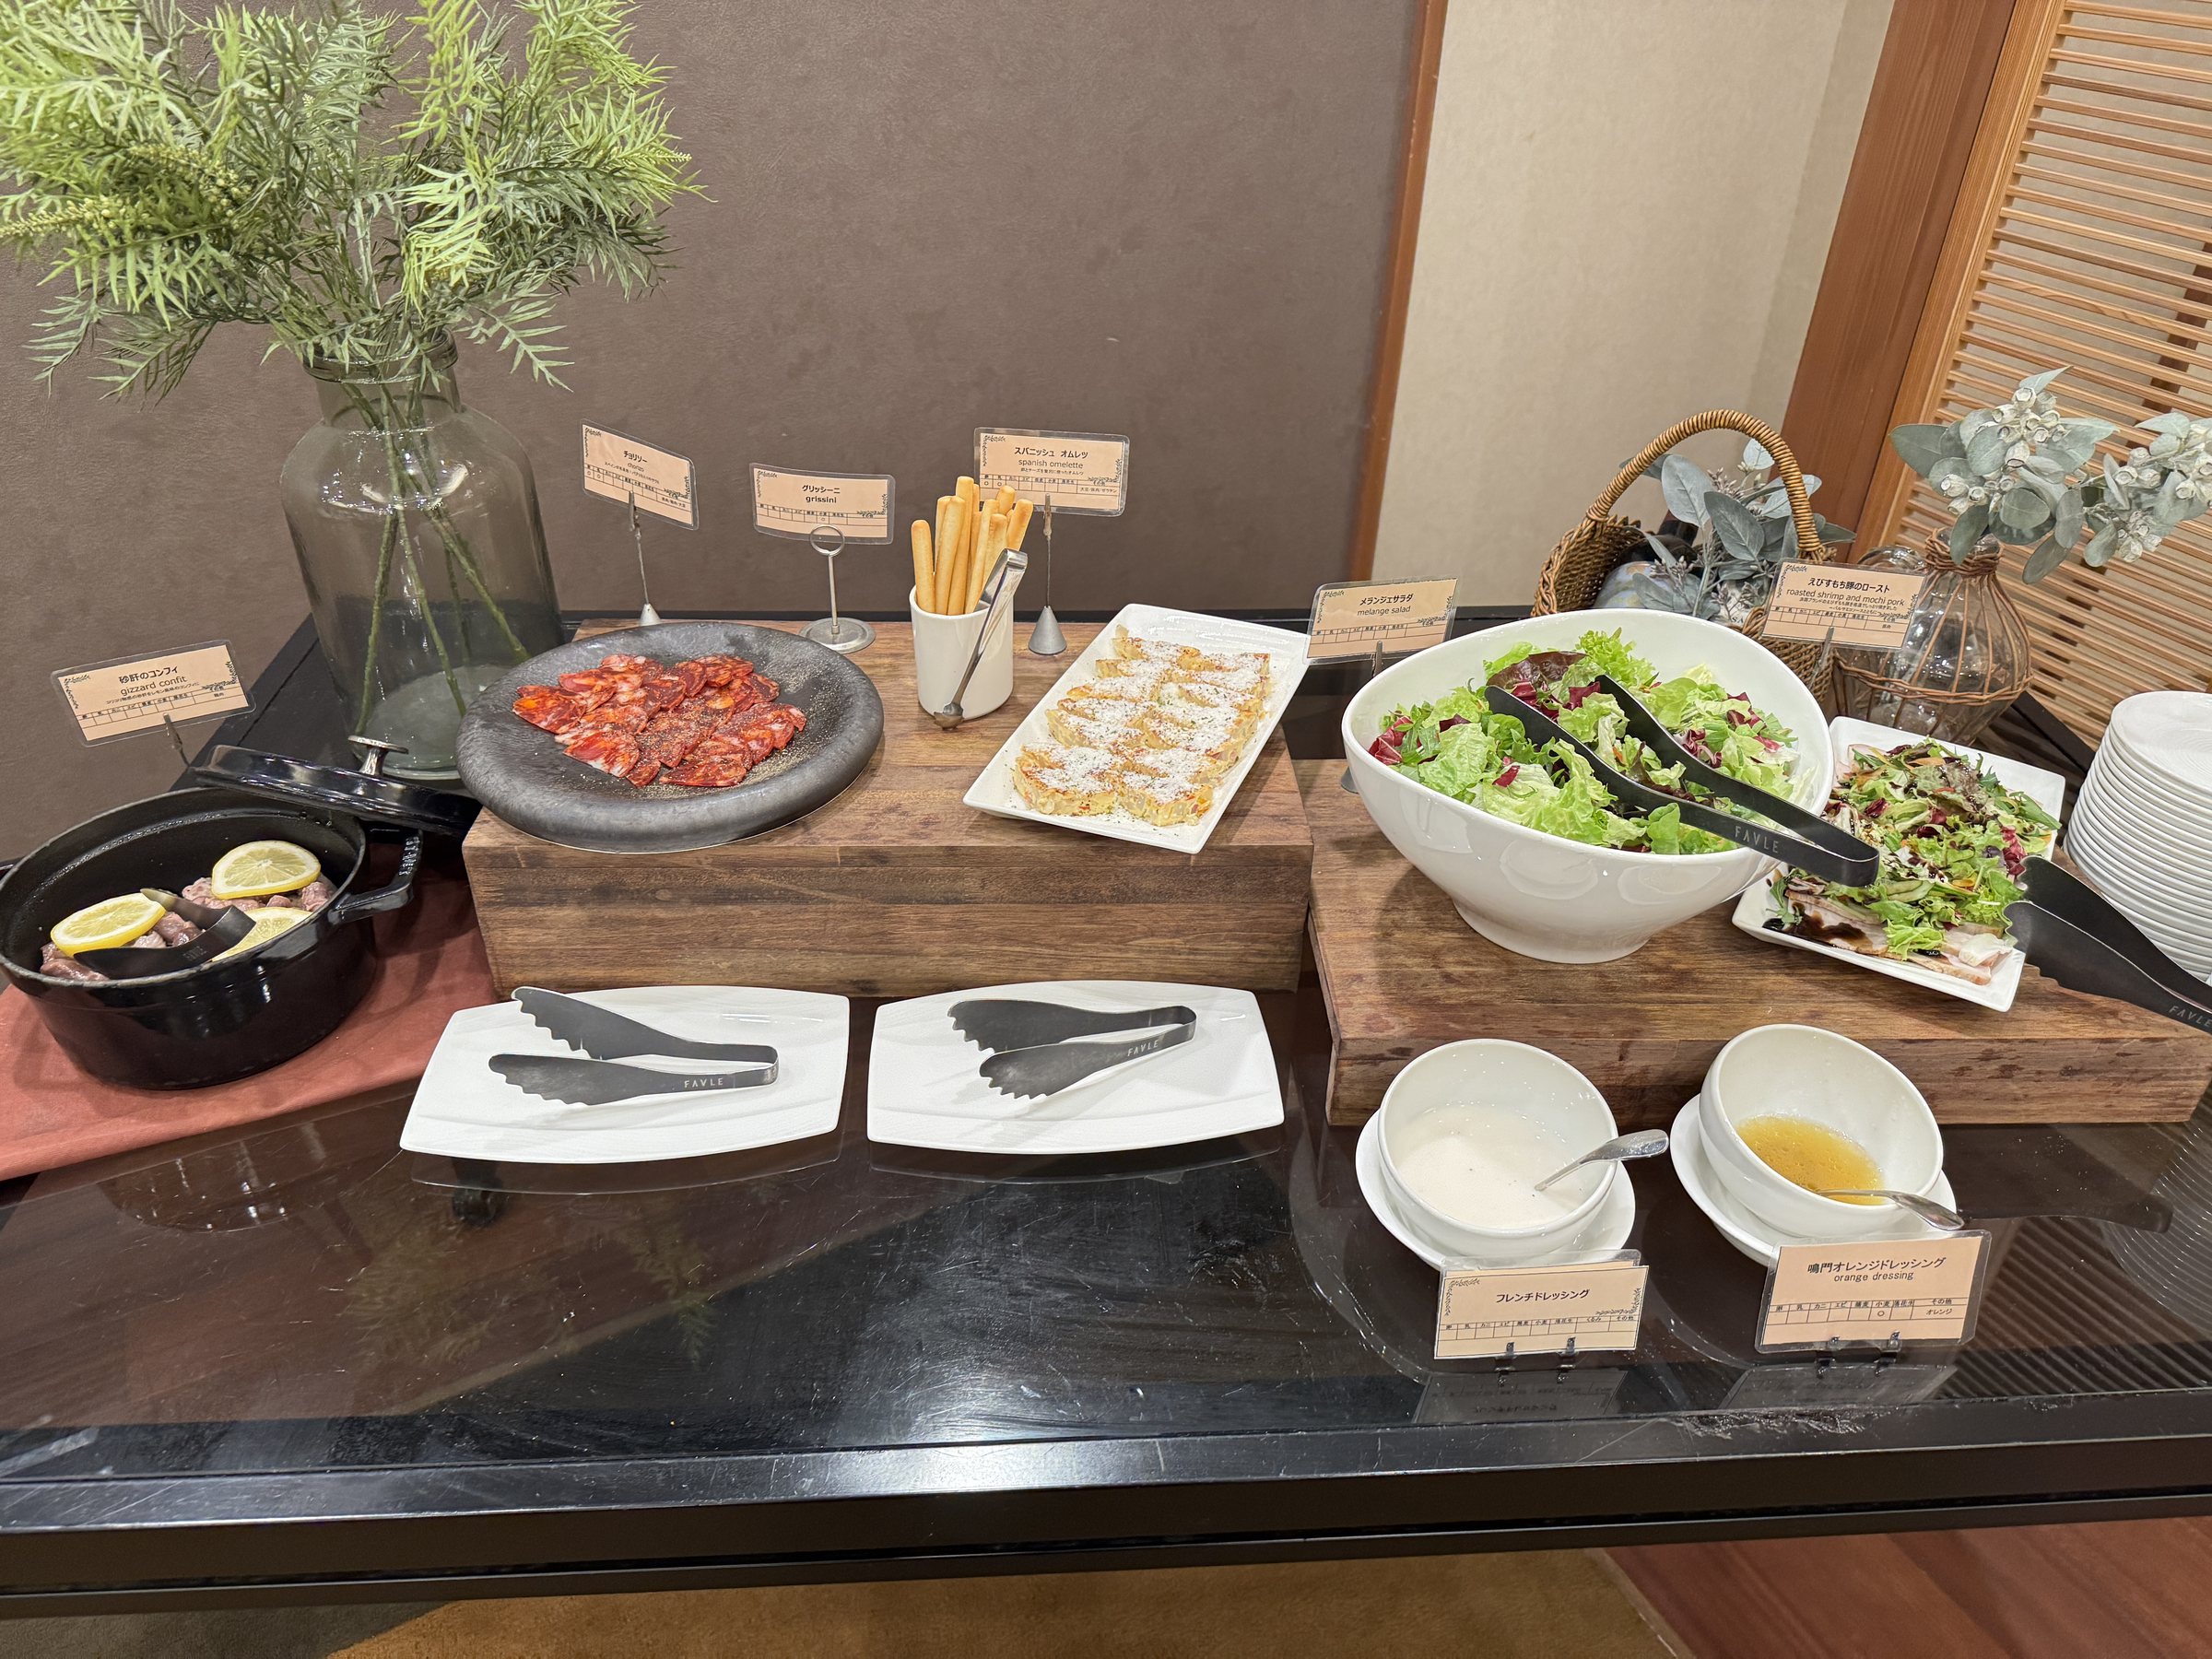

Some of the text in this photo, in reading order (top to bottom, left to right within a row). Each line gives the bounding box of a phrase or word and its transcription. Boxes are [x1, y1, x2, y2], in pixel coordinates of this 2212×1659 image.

[624, 451, 647, 463] チョリソー
[1060, 450, 1088, 459] オムレツ
[1050, 461, 1084, 469] omelette
[802, 485, 841, 494] グリッシーニ
[806, 495, 837, 504] grissini
[1808, 577, 1890, 593] えびすもち豚のロースト
[1359, 593, 1414, 606] メランジェサラダ
[1786, 588, 1816, 597] roasted
[1818, 591, 1844, 600] shrimp
[1357, 606, 1411, 617] melange salad
[119, 666, 178, 684] 砂肝のコンフィ
[121, 676, 187, 696] gizzard confit
[1735, 825, 1779, 853] FAVLE
[2169, 1006, 2212, 1028] FAVLE
[1127, 1040, 1159, 1057] FAVLE
[684, 1077, 724, 1088] FAVLE
[1807, 1256, 1947, 1274] 鳴門オレンジドレッシング
[1834, 1271, 1914, 1282] orange dressing
[1496, 1288, 1590, 1303] フレンチドレッシング
